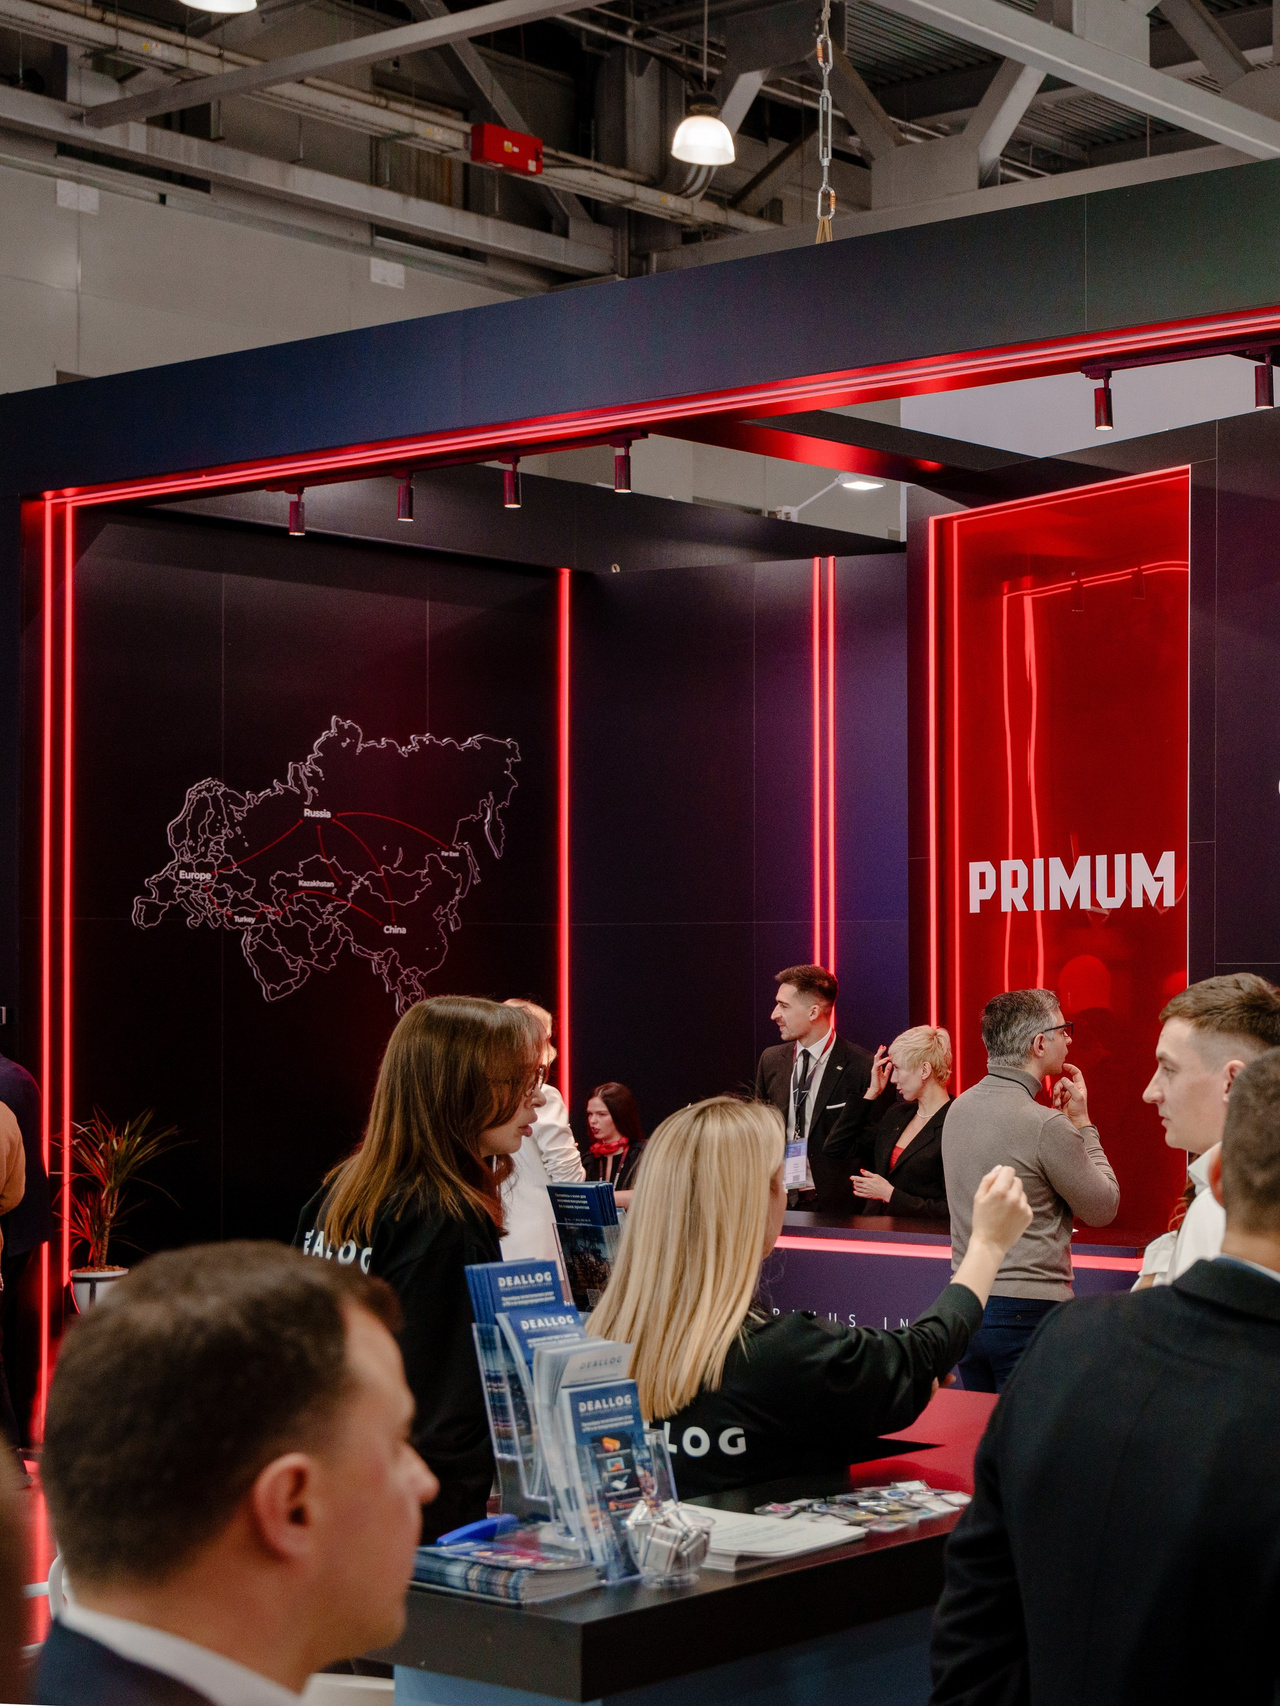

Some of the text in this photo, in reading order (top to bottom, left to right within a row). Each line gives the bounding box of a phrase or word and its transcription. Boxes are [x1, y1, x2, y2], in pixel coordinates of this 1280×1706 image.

[304, 808, 331, 819] Russia
[179, 870, 212, 881] Europe
[969, 851, 1175, 913] PRIMUM
[298, 879, 335, 888] Kazakhstan
[383, 925, 407, 934] China
[498, 1271, 552, 1287] DEALLOG
[520, 1314, 574, 1331] DEALLOG
[578, 1394, 632, 1413] DEALLOG
